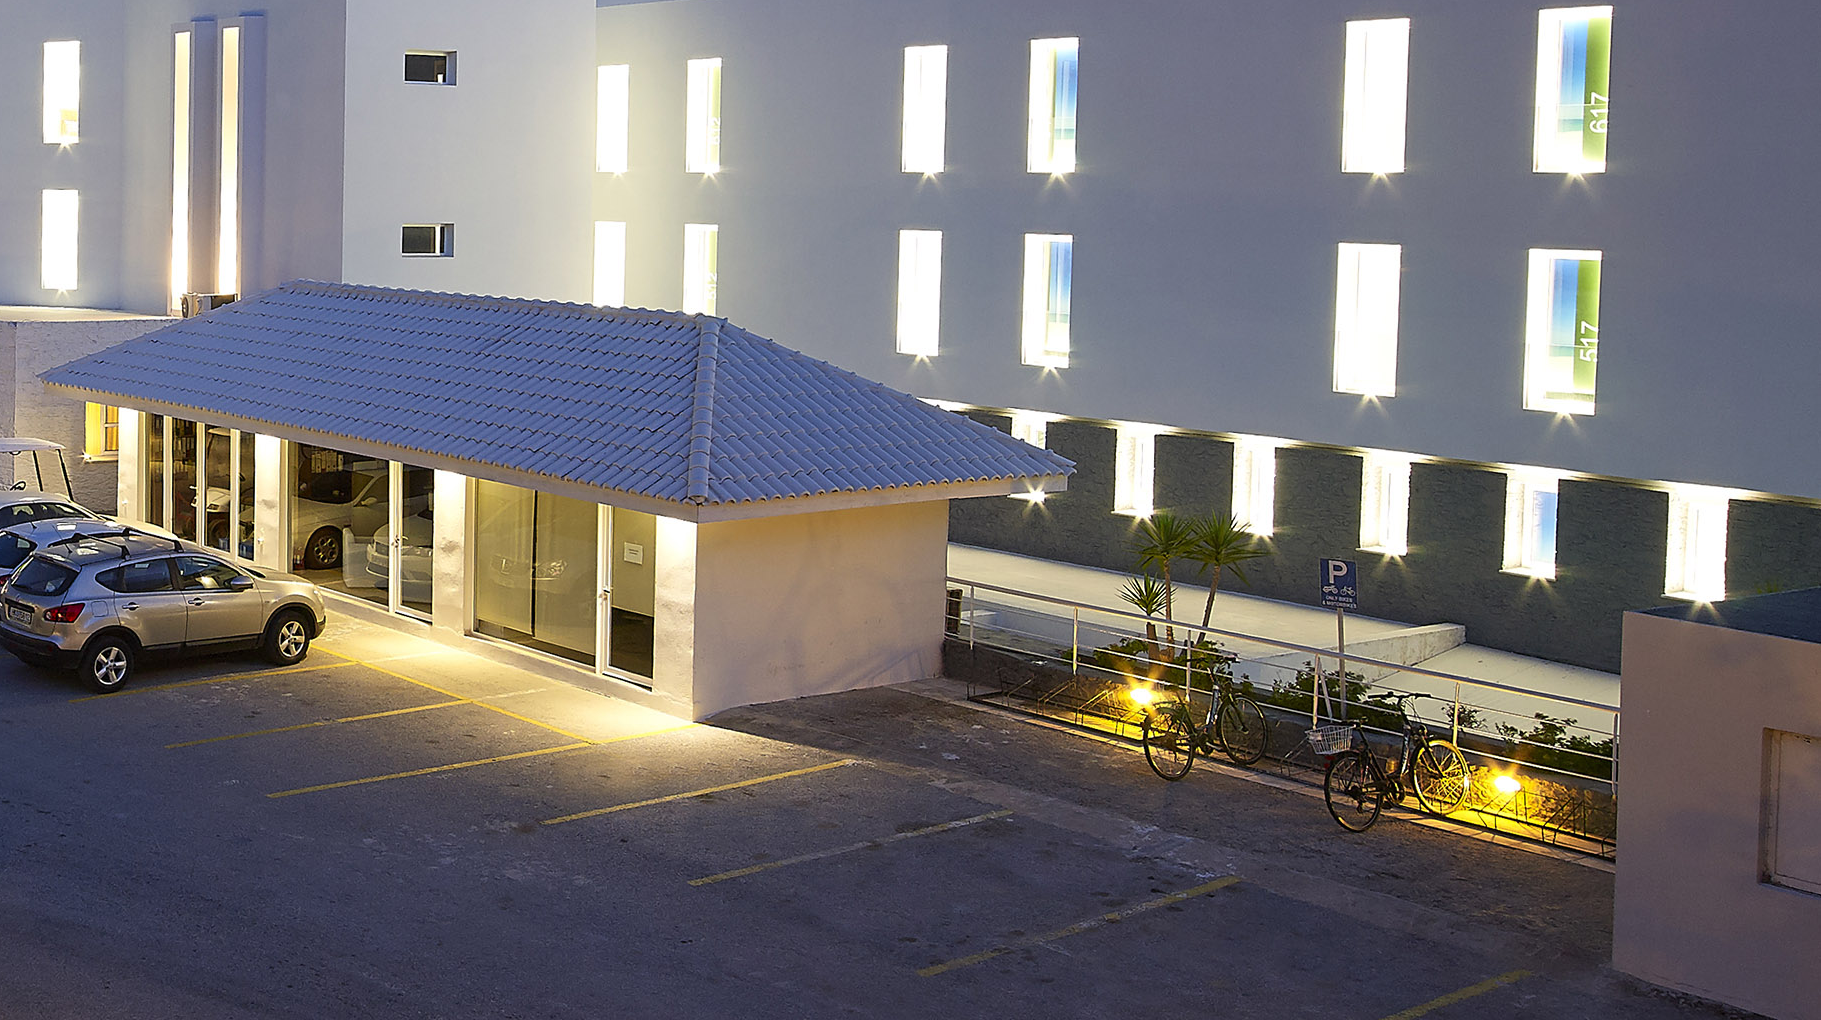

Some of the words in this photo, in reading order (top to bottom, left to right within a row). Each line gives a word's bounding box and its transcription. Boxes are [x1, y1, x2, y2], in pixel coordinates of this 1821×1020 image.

[1589, 92, 1609, 134] 617
[1579, 320, 1599, 362] 517
[1328, 560, 1348, 584] P
